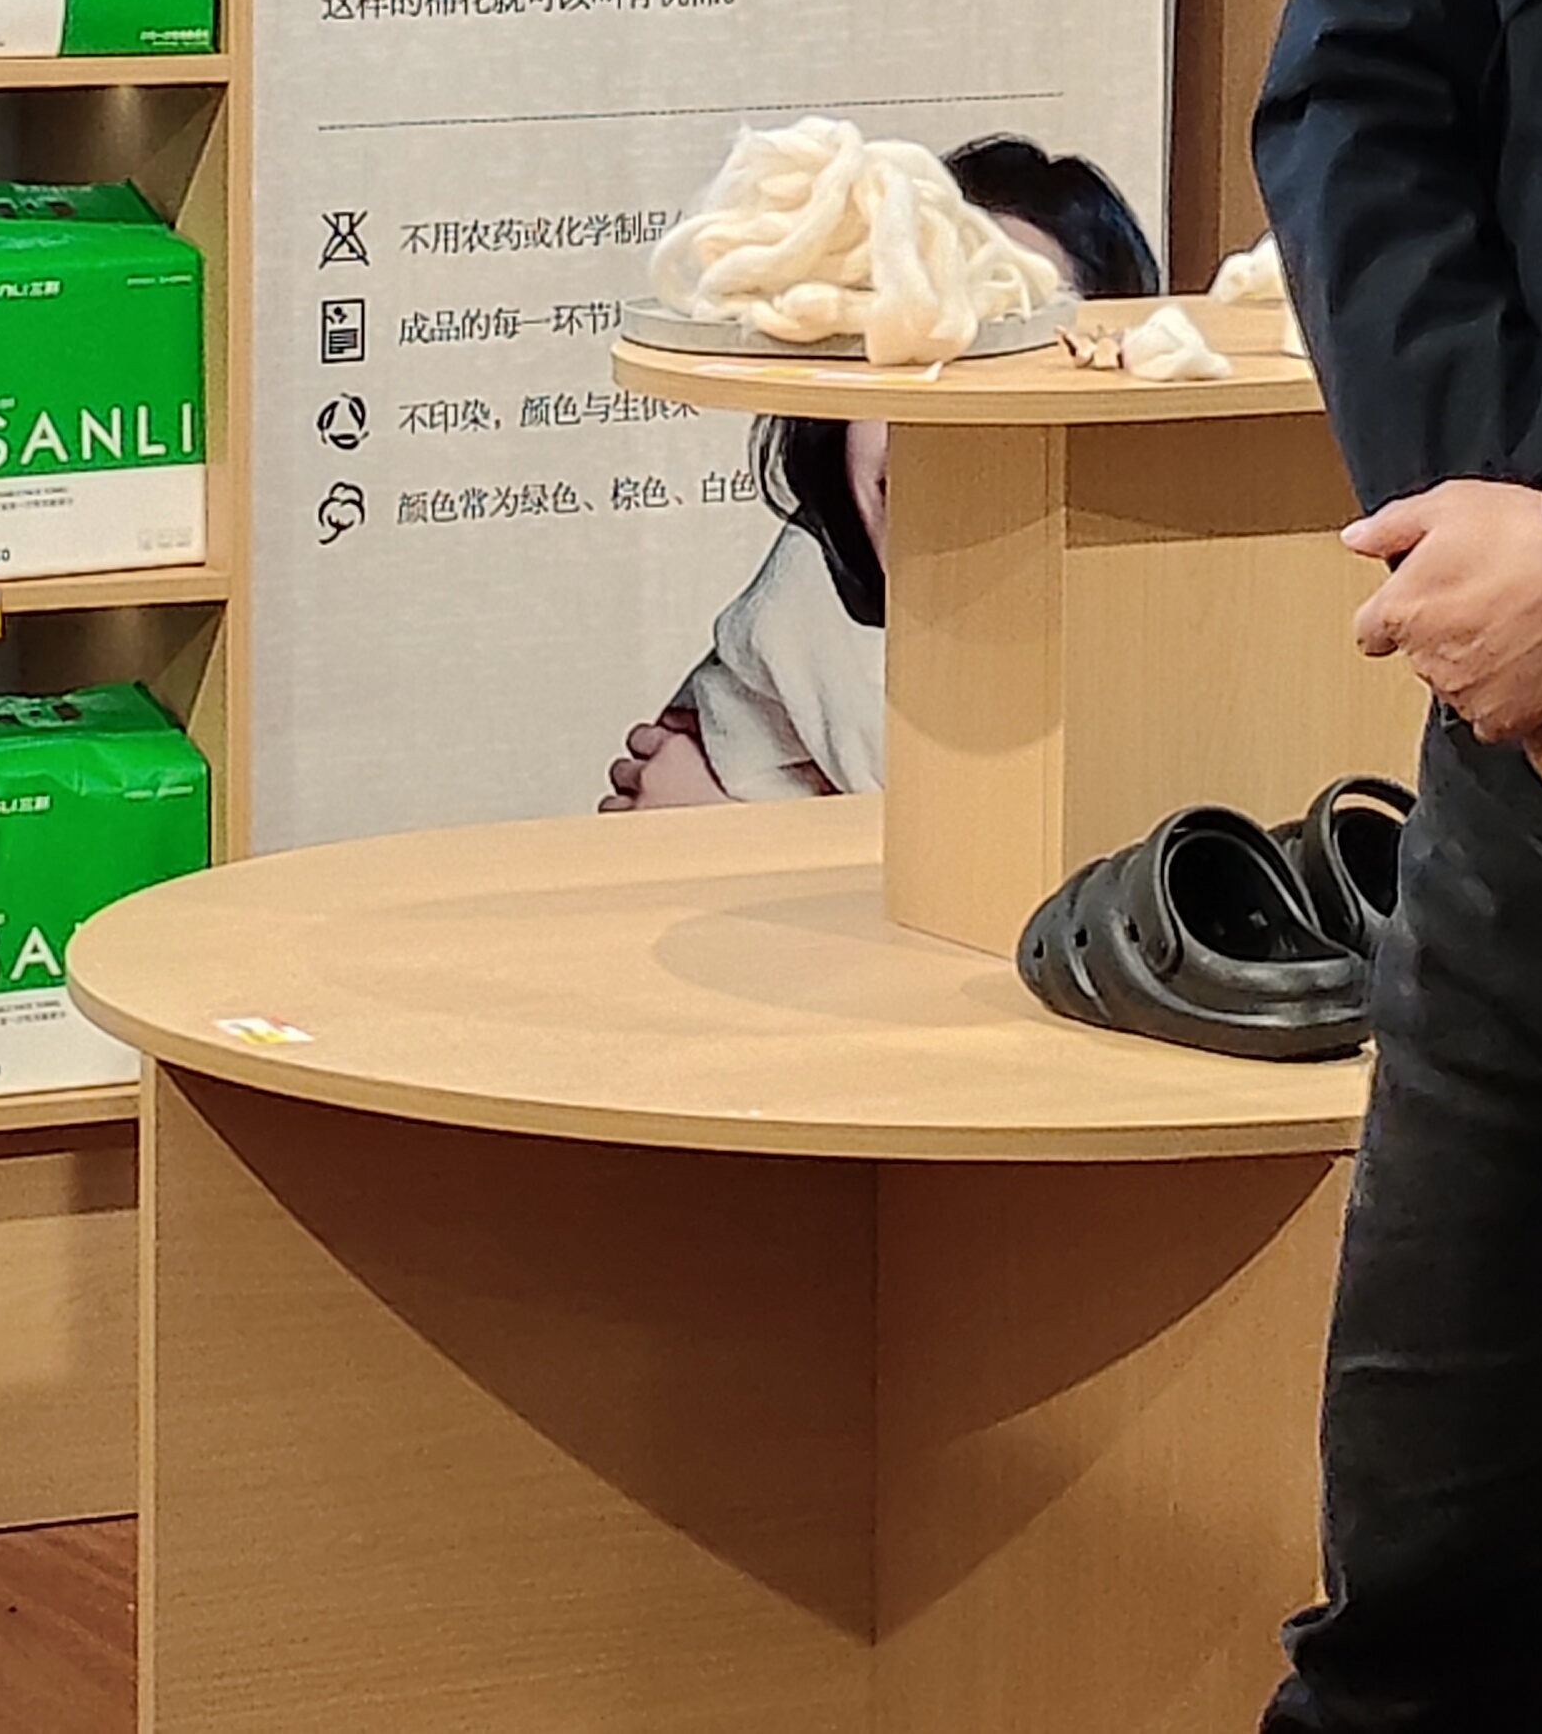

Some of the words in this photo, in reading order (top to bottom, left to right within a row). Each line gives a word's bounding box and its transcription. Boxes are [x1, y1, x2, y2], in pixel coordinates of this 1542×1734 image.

[399, 210, 681, 254] 不用农药或化学制品
[399, 300, 621, 346] 成品的每一环节
